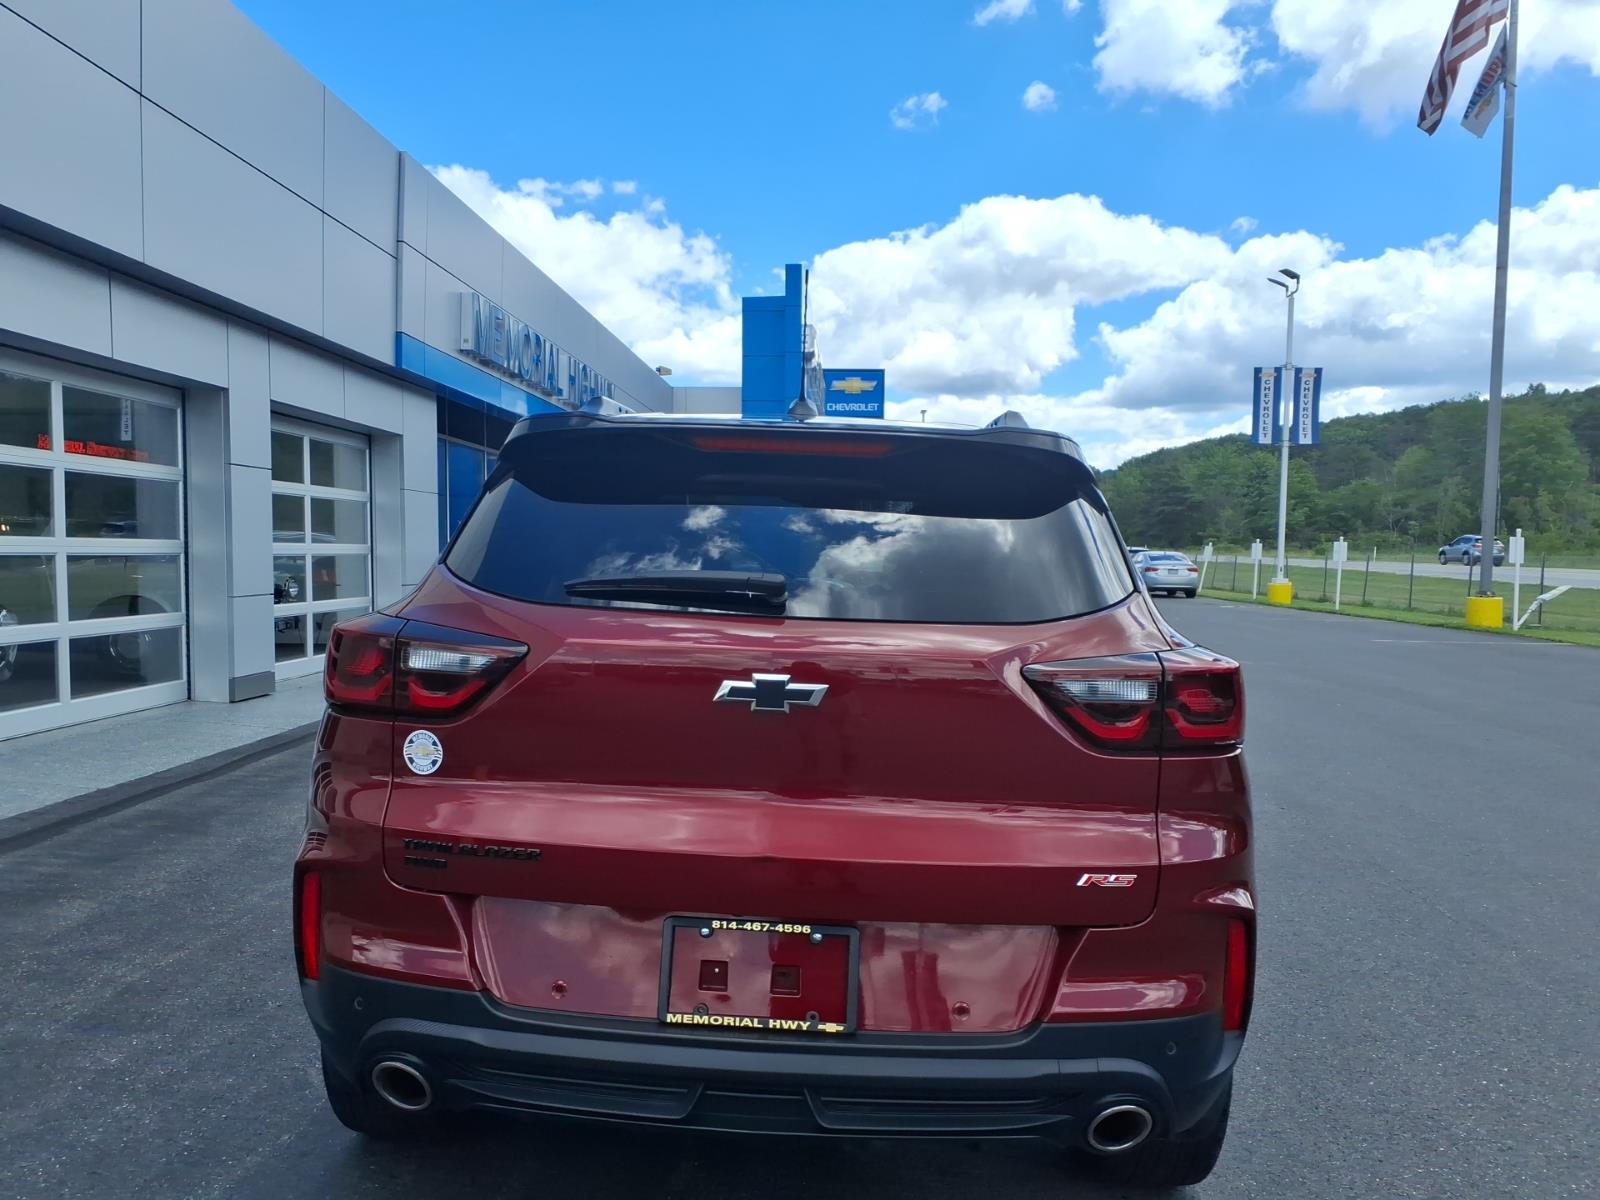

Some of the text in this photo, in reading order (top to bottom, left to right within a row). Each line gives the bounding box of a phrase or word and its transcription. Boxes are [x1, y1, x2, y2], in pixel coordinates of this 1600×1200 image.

[459, 291, 568, 400] MEMORIAL
[826, 402, 880, 411] CHEVROLET
[1262, 379, 1272, 439] CHEVROLET
[1302, 379, 1312, 439] CHEVROLET
[1076, 873, 1138, 887] RS
[711, 920, 811, 934] 814-467-4596
[666, 1013, 811, 1031] MEMORIAL HWY
